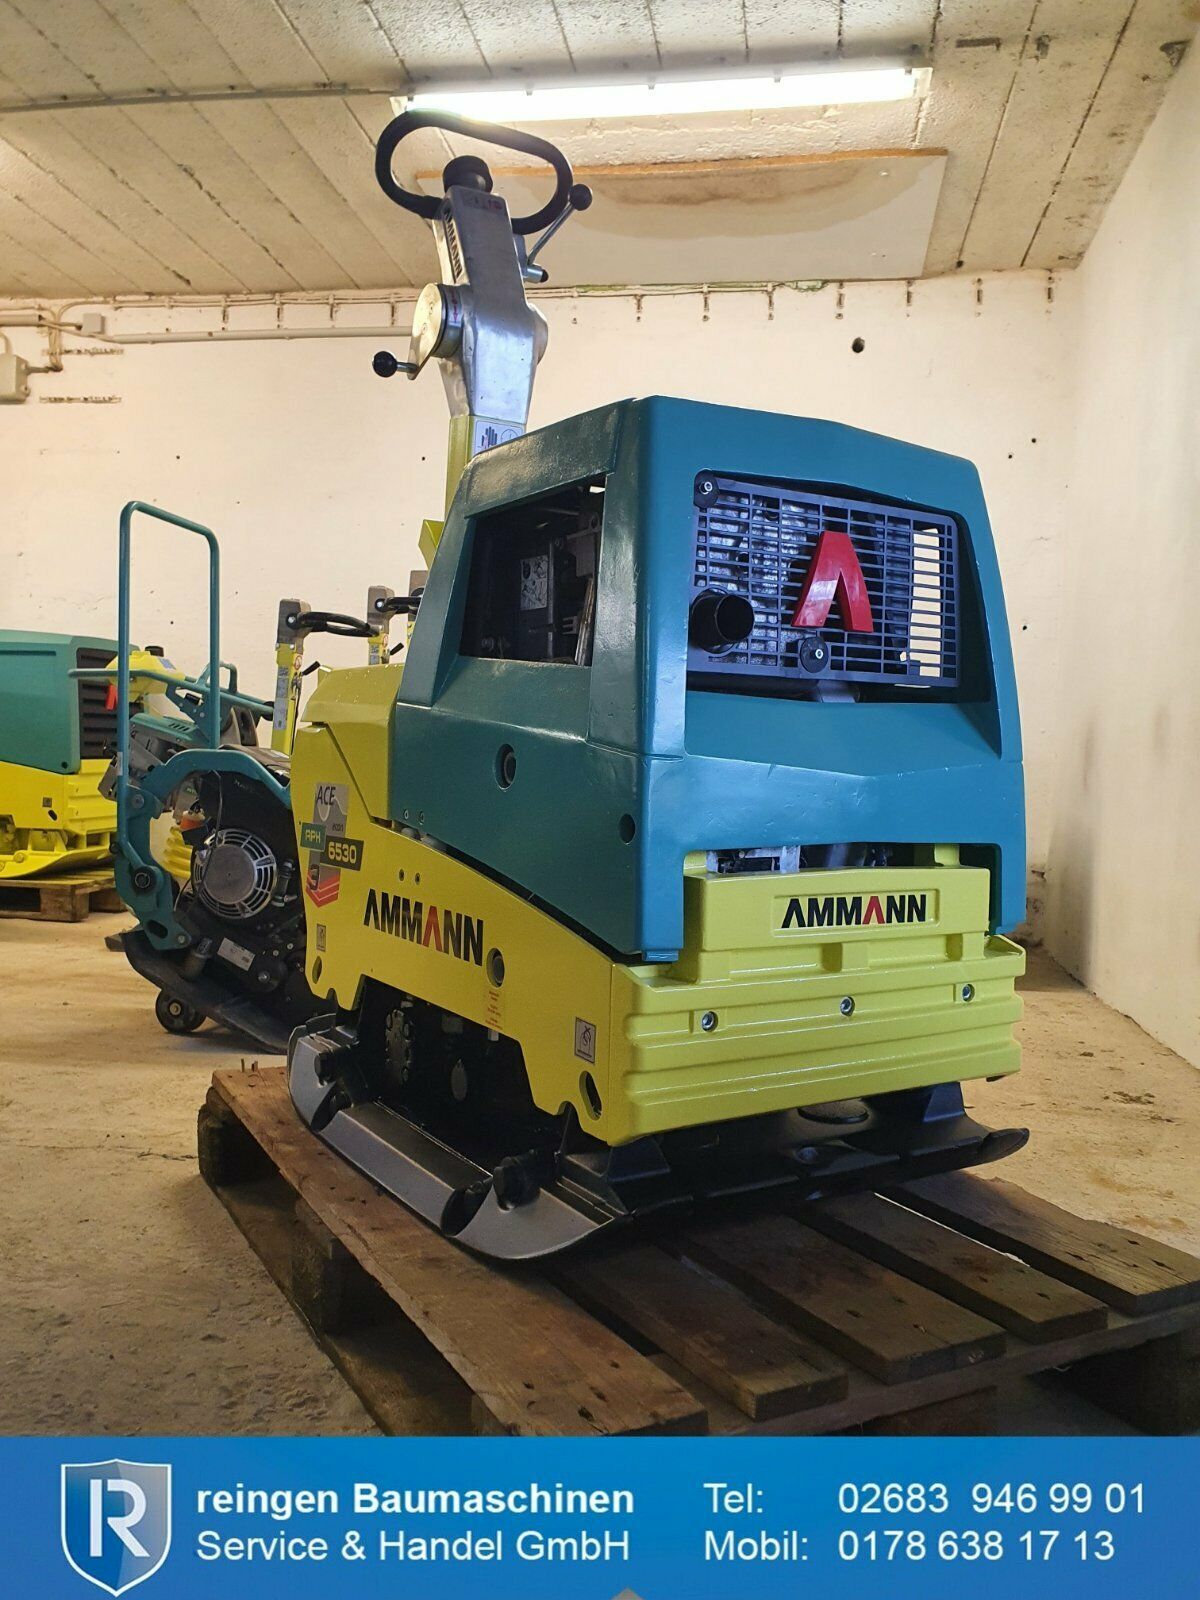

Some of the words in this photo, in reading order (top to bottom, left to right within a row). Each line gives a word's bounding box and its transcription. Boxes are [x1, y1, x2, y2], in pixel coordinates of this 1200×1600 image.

[316, 785, 336, 806] ACE
[327, 840, 358, 865] 6530
[781, 894, 927, 929] AMMANN
[363, 888, 484, 967] AMMANN
